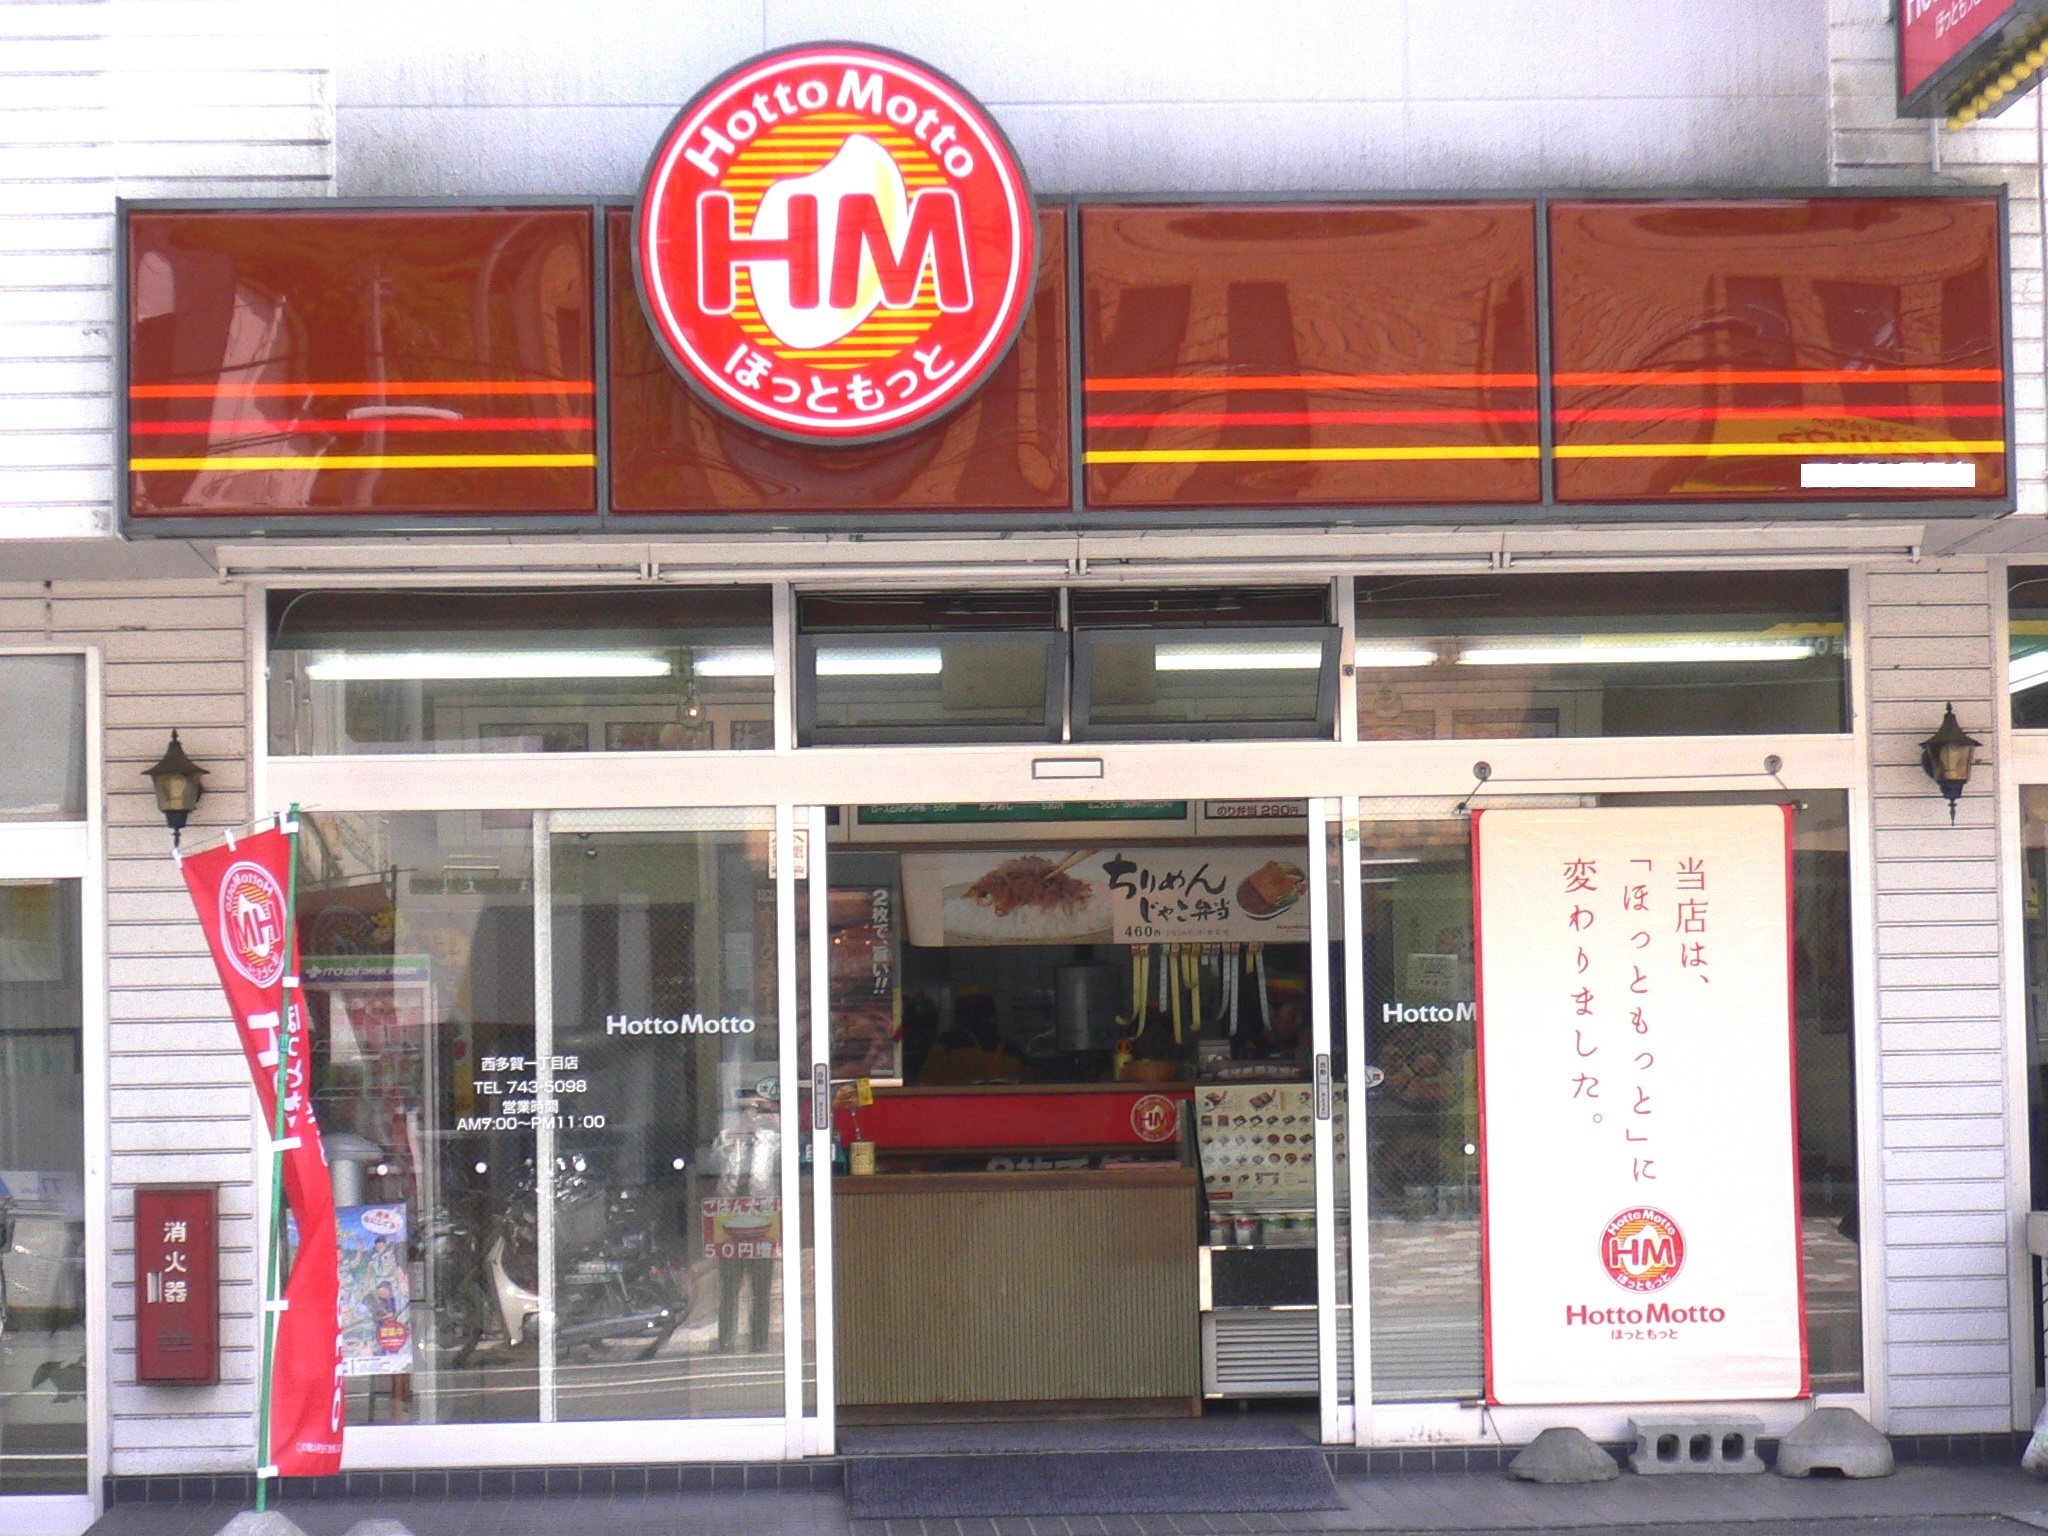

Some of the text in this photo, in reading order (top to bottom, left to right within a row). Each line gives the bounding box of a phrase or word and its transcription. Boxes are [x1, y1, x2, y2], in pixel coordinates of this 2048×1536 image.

[697, 188, 974, 316] HM
[723, 344, 955, 413] ほっともっと
[1102, 853, 1227, 900] ちりめん
[1139, 896, 1231, 924] じゃこ弁当
[1675, 856, 1709, 984] 当店は、
[1562, 857, 1603, 1124] 変わりました。
[1623, 859, 1657, 1182] 「ほっともっと」に
[473, 1081, 503, 1095] TEL
[502, 1099, 559, 1115] 営業時間
[163, 1221, 188, 1303] 消火器
[1609, 1237, 1676, 1269] HM
[1616, 1272, 1672, 1291] ほっともっと
[1611, 1328, 1679, 1341] ほっともっと
